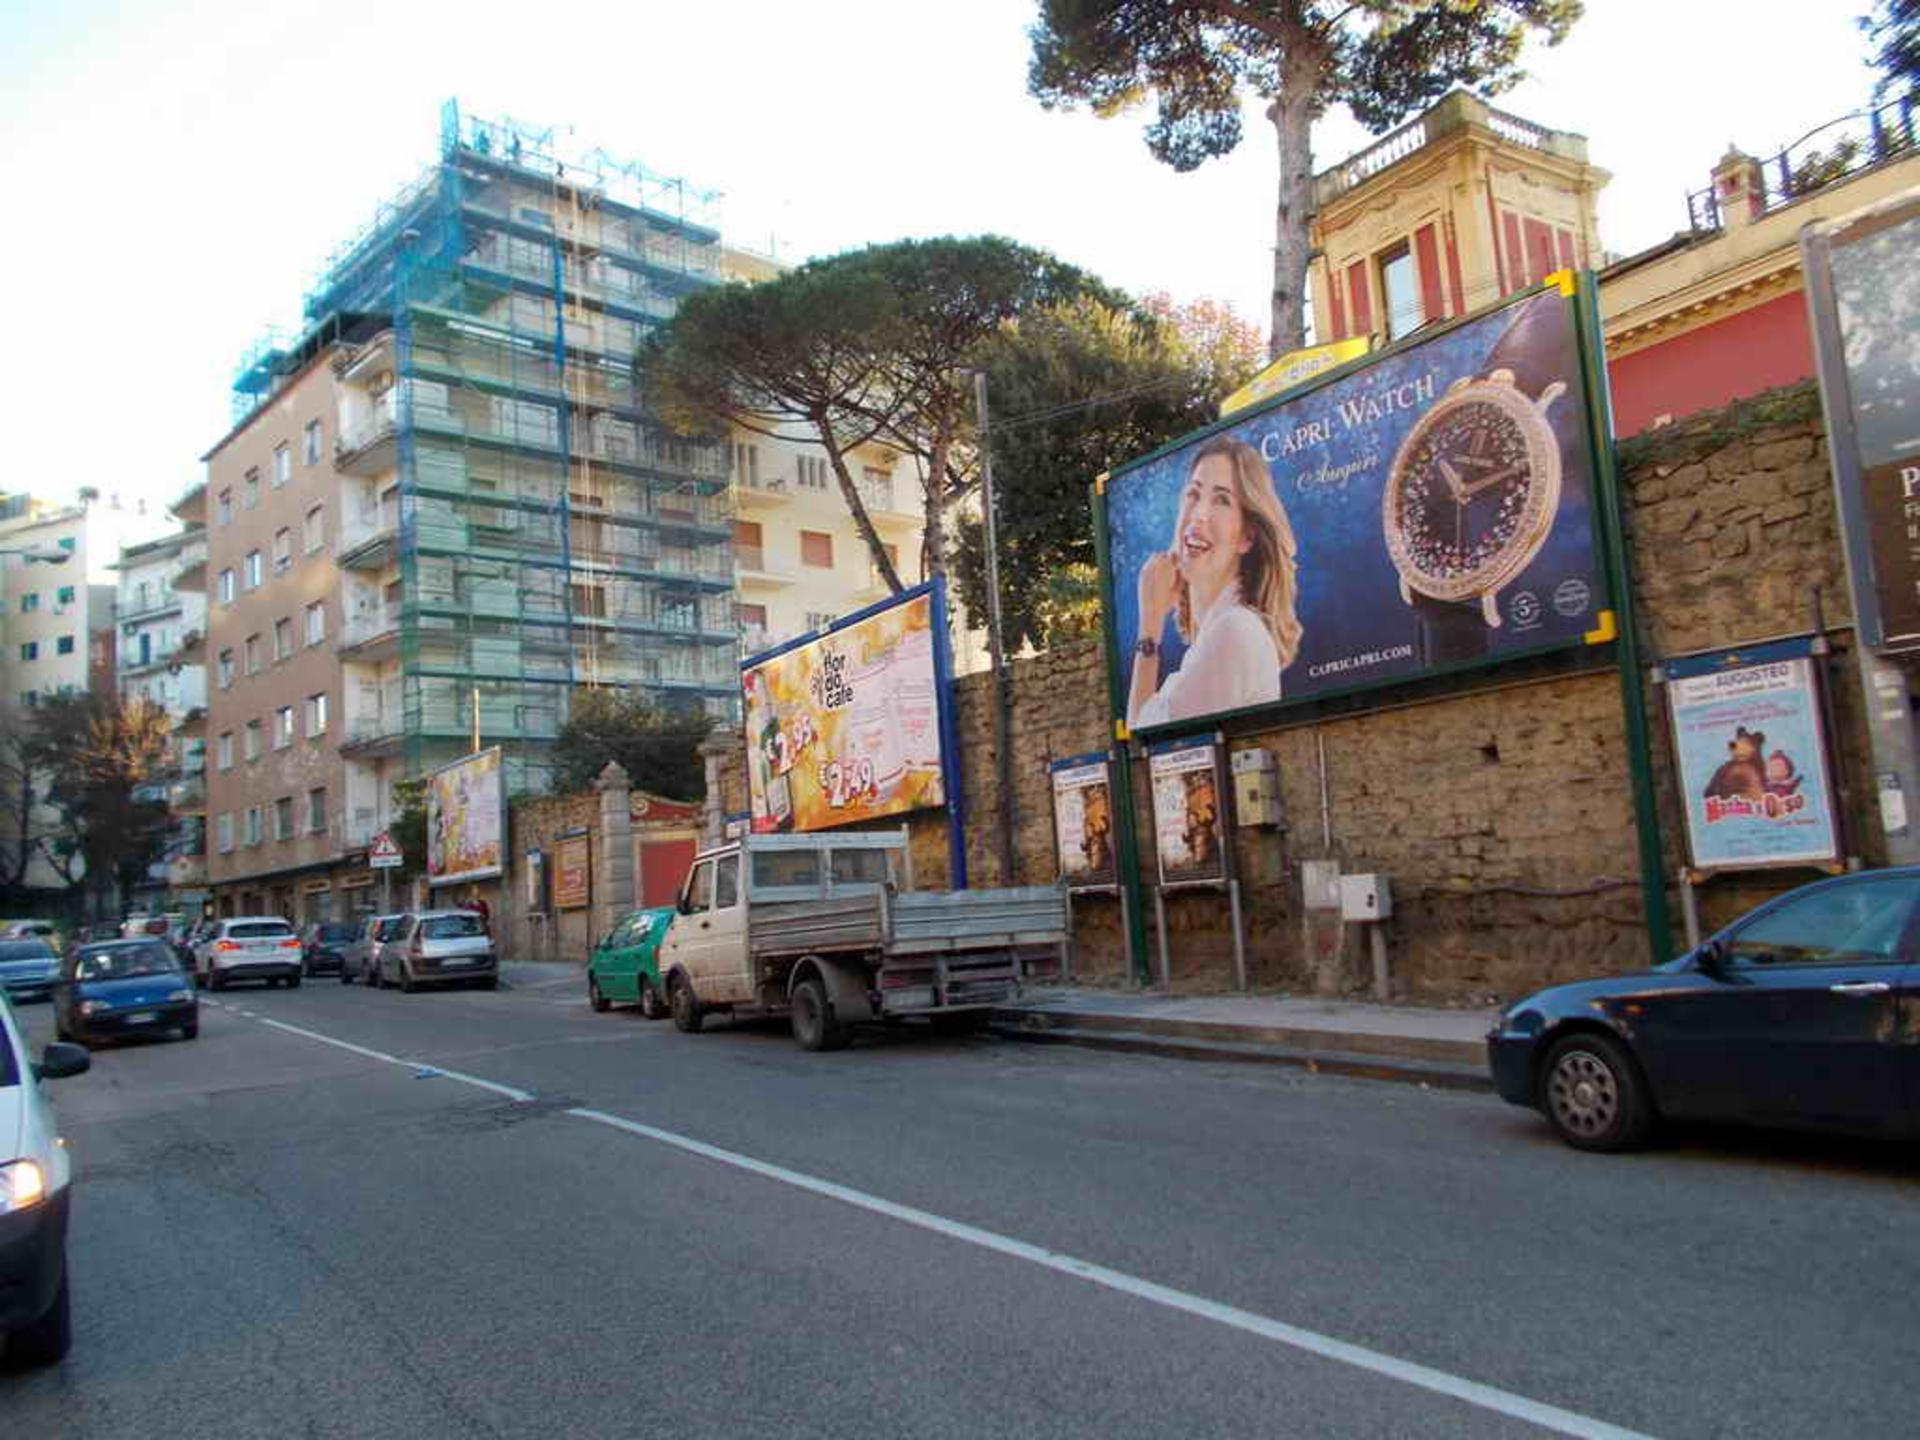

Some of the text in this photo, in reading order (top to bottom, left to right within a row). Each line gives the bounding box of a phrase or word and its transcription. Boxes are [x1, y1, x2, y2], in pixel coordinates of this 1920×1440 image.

[1261, 374, 1434, 462] CAPRI WATCH
[825, 673, 842, 692] do
